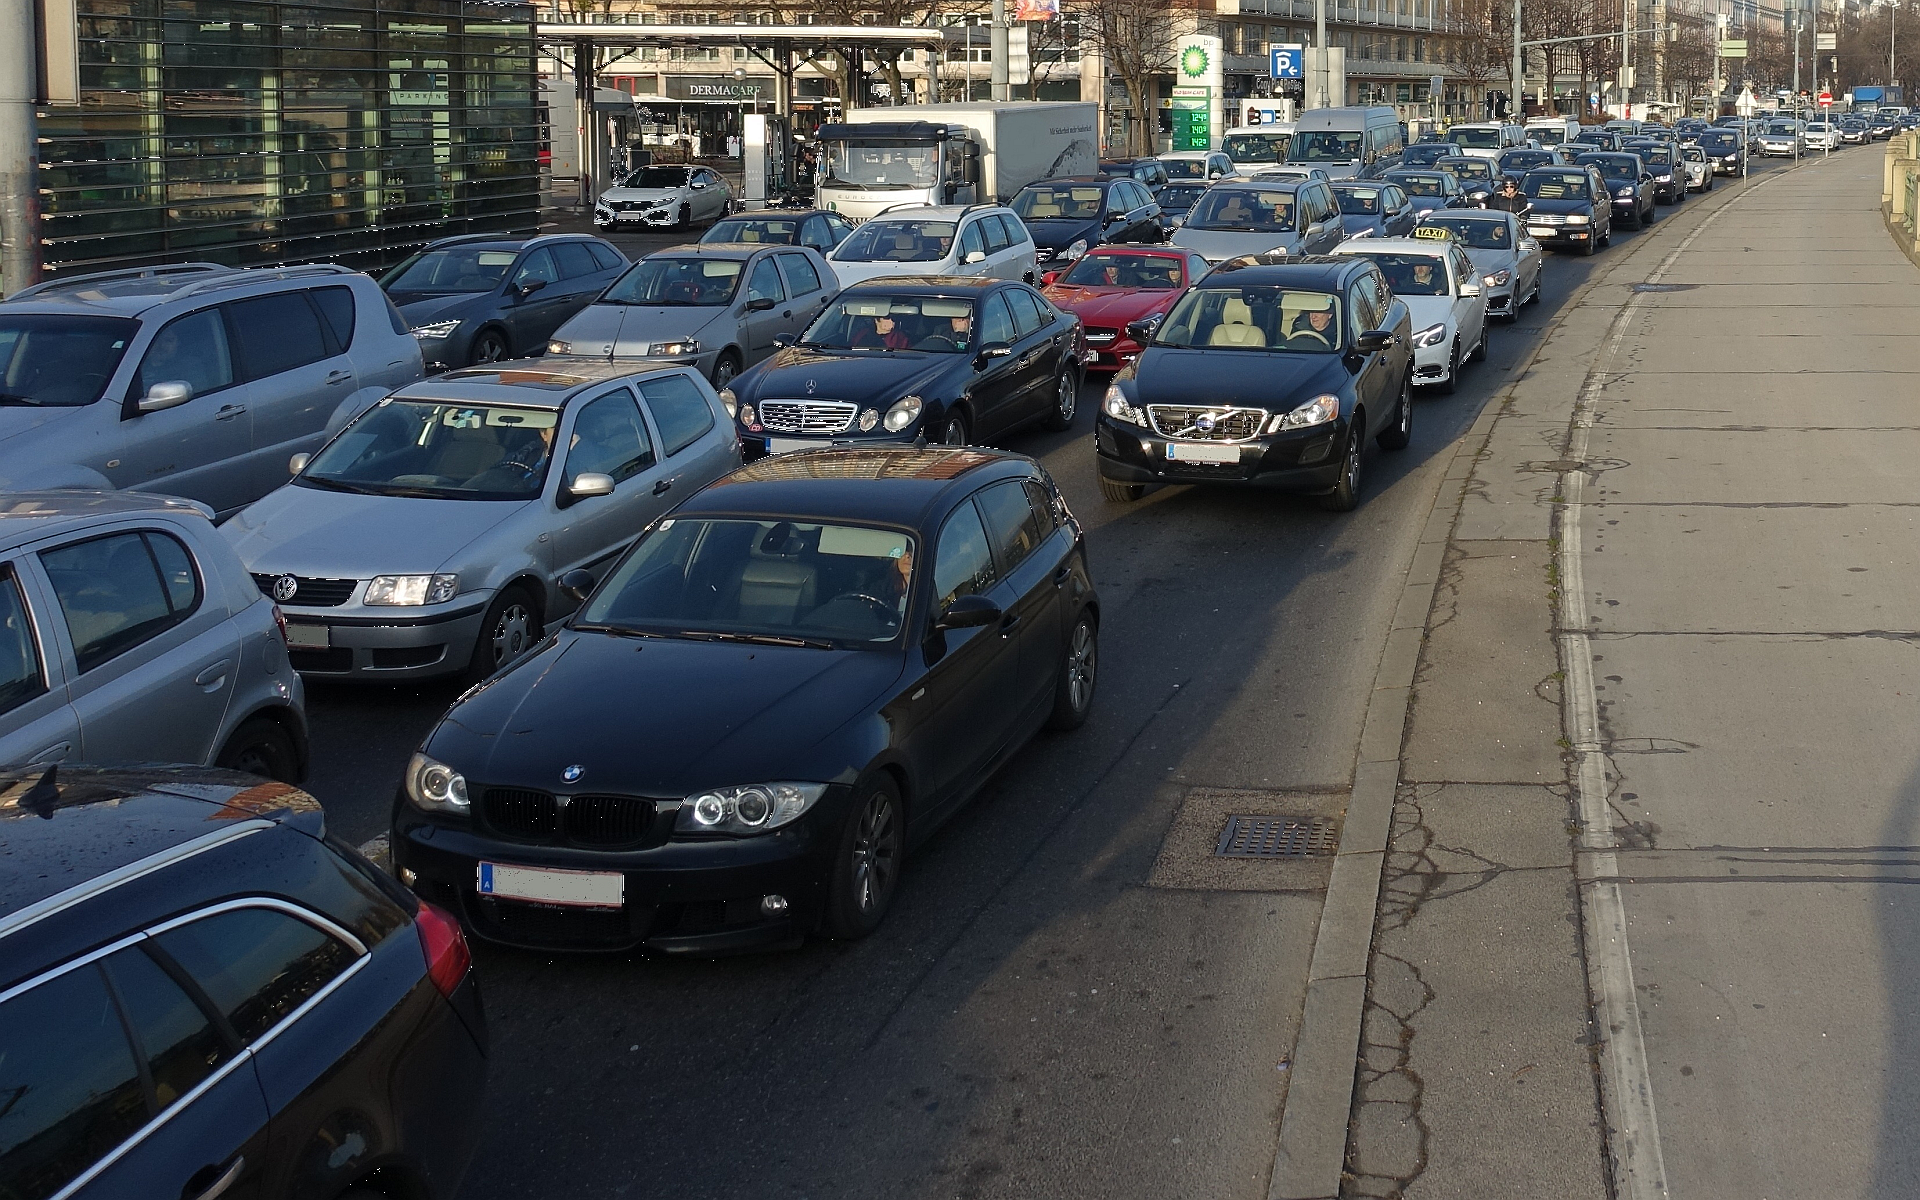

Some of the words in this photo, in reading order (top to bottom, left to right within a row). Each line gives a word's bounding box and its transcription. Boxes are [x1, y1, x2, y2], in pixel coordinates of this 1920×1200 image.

[1203, 38, 1214, 47] bp
[1277, 57, 1290, 76] P
[1418, 229, 1444, 237] TAXI
[484, 881, 491, 889] A
